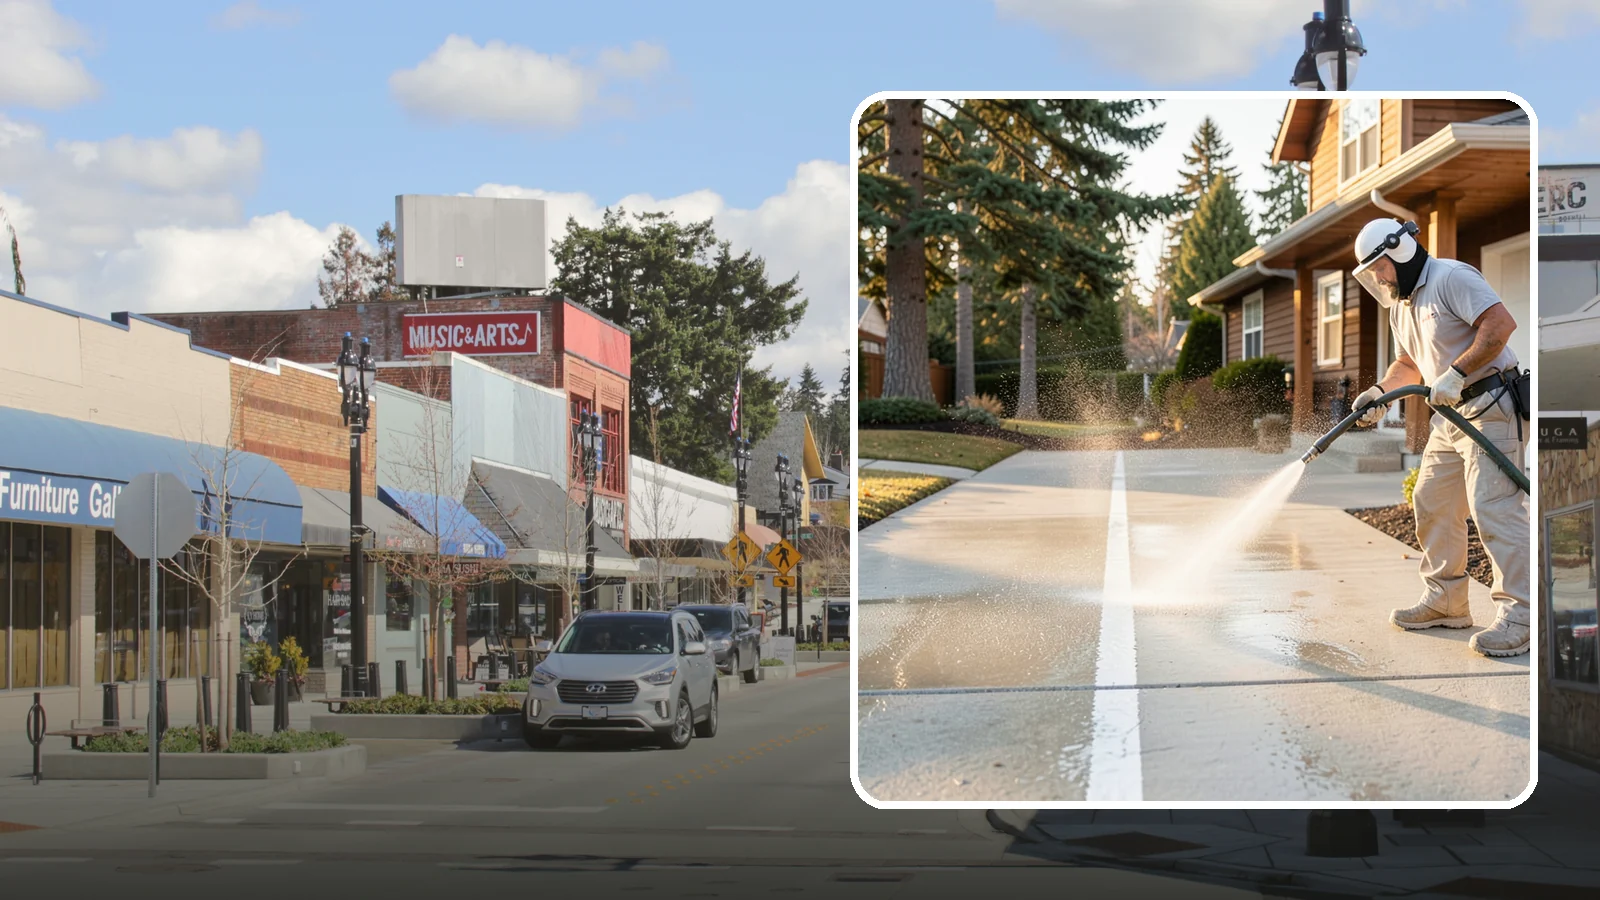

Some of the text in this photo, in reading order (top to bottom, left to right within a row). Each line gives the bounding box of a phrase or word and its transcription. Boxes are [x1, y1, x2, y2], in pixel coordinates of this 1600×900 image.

[408, 322, 519, 348] MUSIC&ARTS
[0, 471, 122, 519] Furniture Gal
